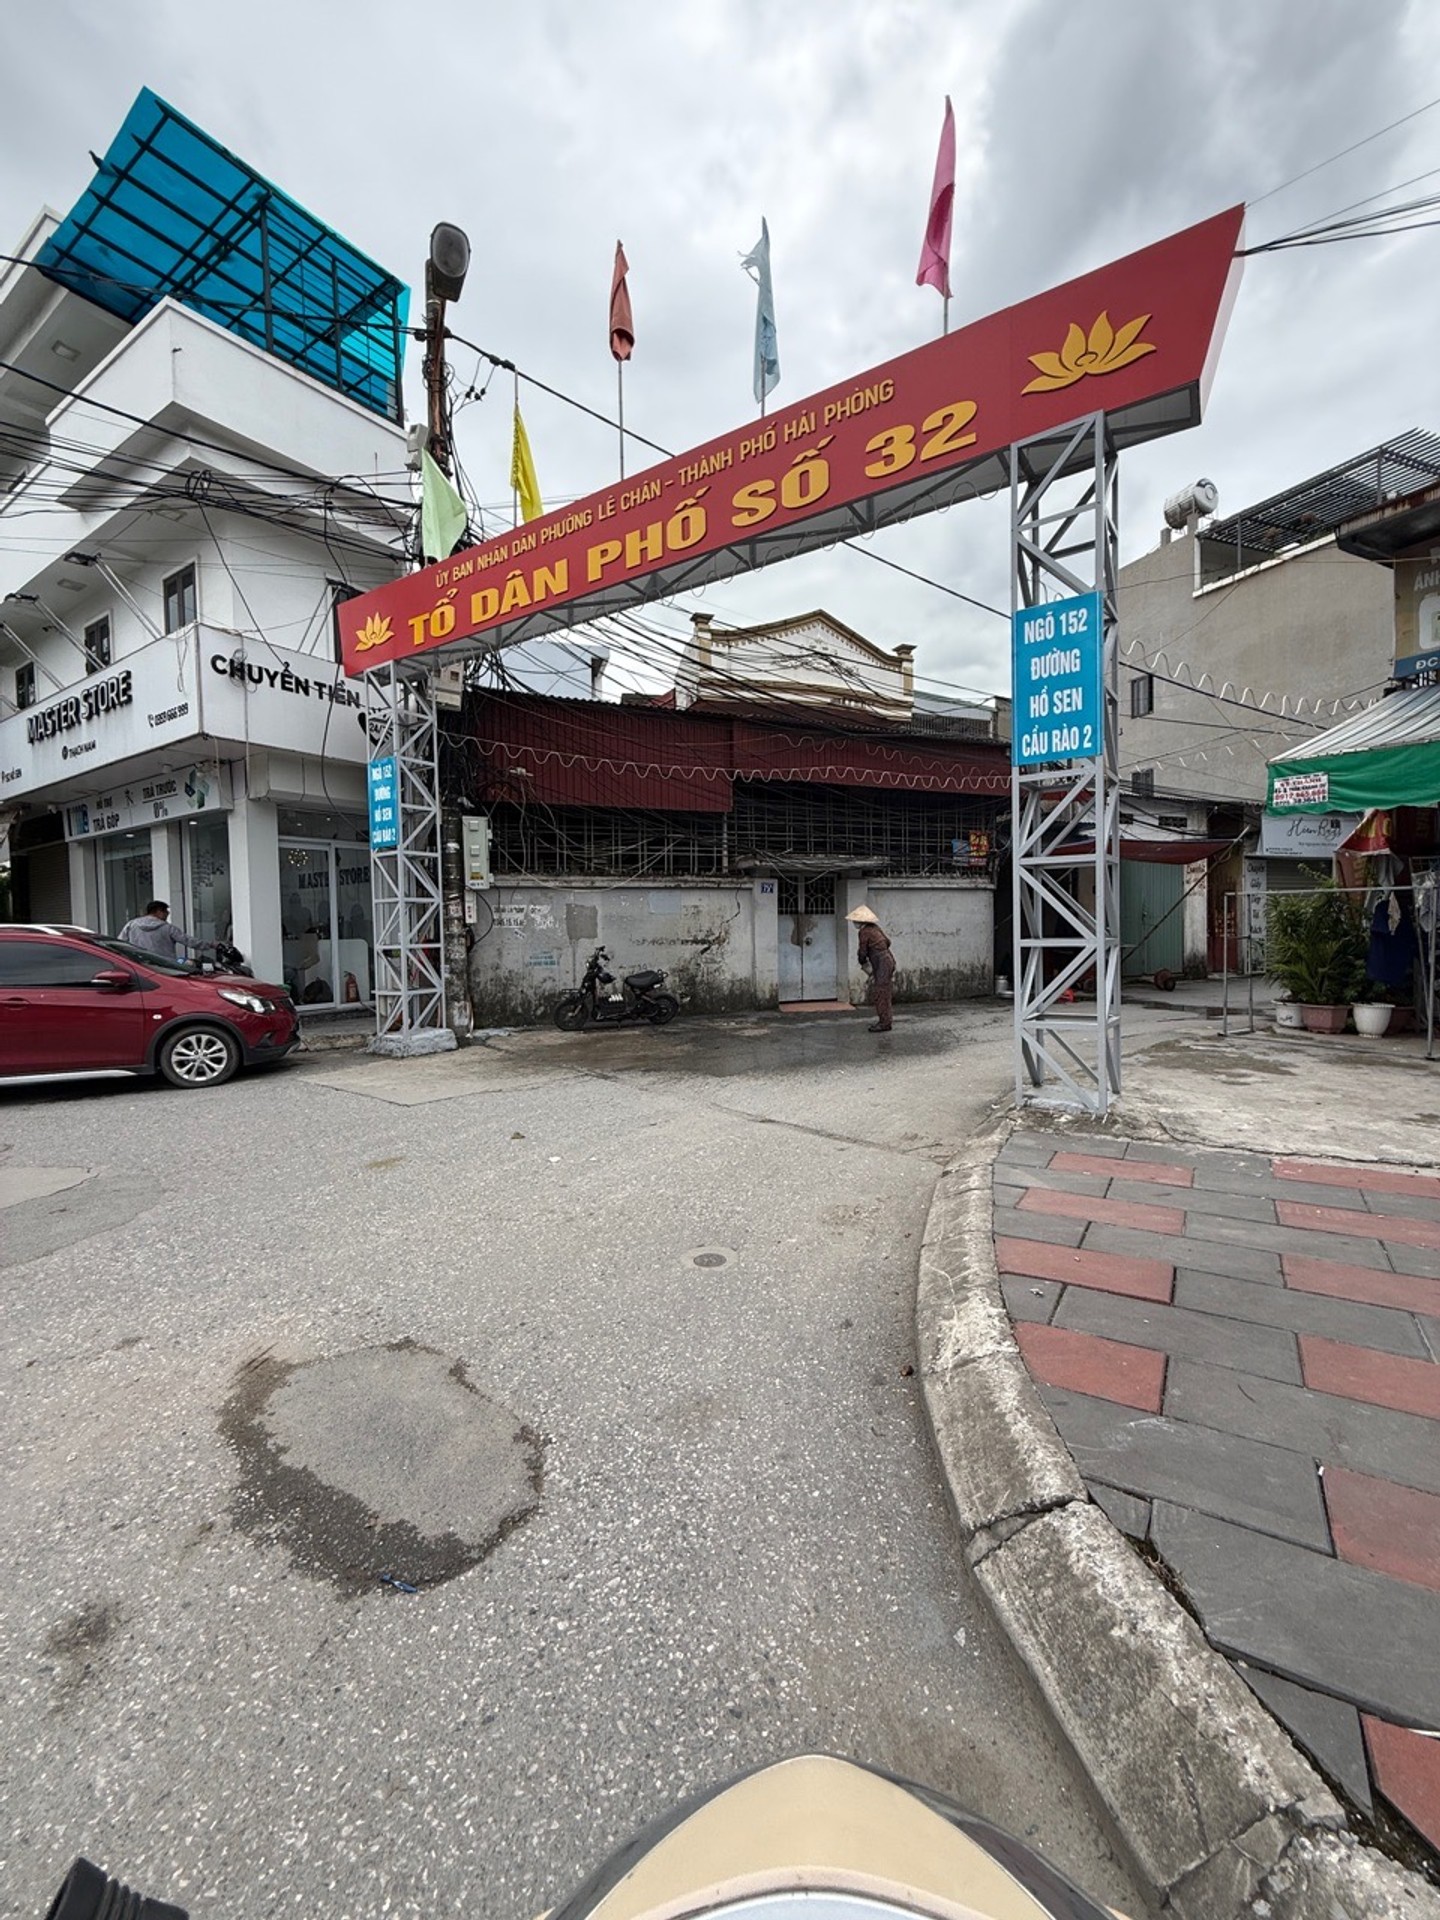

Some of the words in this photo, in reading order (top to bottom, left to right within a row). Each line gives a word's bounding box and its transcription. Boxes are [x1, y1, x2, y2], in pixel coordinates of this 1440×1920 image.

[436, 568, 450, 588] ỦY
[453, 559, 474, 580] BAN
[477, 544, 508, 570] NHÂN
[512, 532, 537, 557] DÂN
[541, 509, 592, 545] PHƯỜNG
[598, 495, 616, 521] LÊ
[620, 479, 662, 512] CHÂN
[678, 446, 733, 487] THÀNH
[740, 420, 777, 462] PHỐ
[784, 409, 816, 443] HẢI
[824, 378, 895, 426] PHÒNG
[408, 588, 458, 646] TỔ
[470, 559, 569, 624] DÂN
[587, 484, 708, 583] PHỐ
[731, 435, 836, 528] SỐ
[864, 400, 978, 478] 32
[1024, 612, 1055, 645] NGÕ
[1059, 608, 1088, 636] 152
[210, 654, 311, 697] CHUYỂN
[313, 680, 361, 709] TIỀN
[1030, 647, 1081, 681] ĐƯỜNG
[27, 695, 82, 746] MASTER
[80, 669, 133, 723] STORE
[1029, 686, 1049, 719] HỒ
[1053, 687, 1083, 715] SEN
[1022, 724, 1048, 757] CẦU
[1052, 723, 1080, 753] RÀO
[1083, 725, 1092, 749] 2
[298, 871, 331, 889] MASTE
[339, 866, 370, 886] STORE
